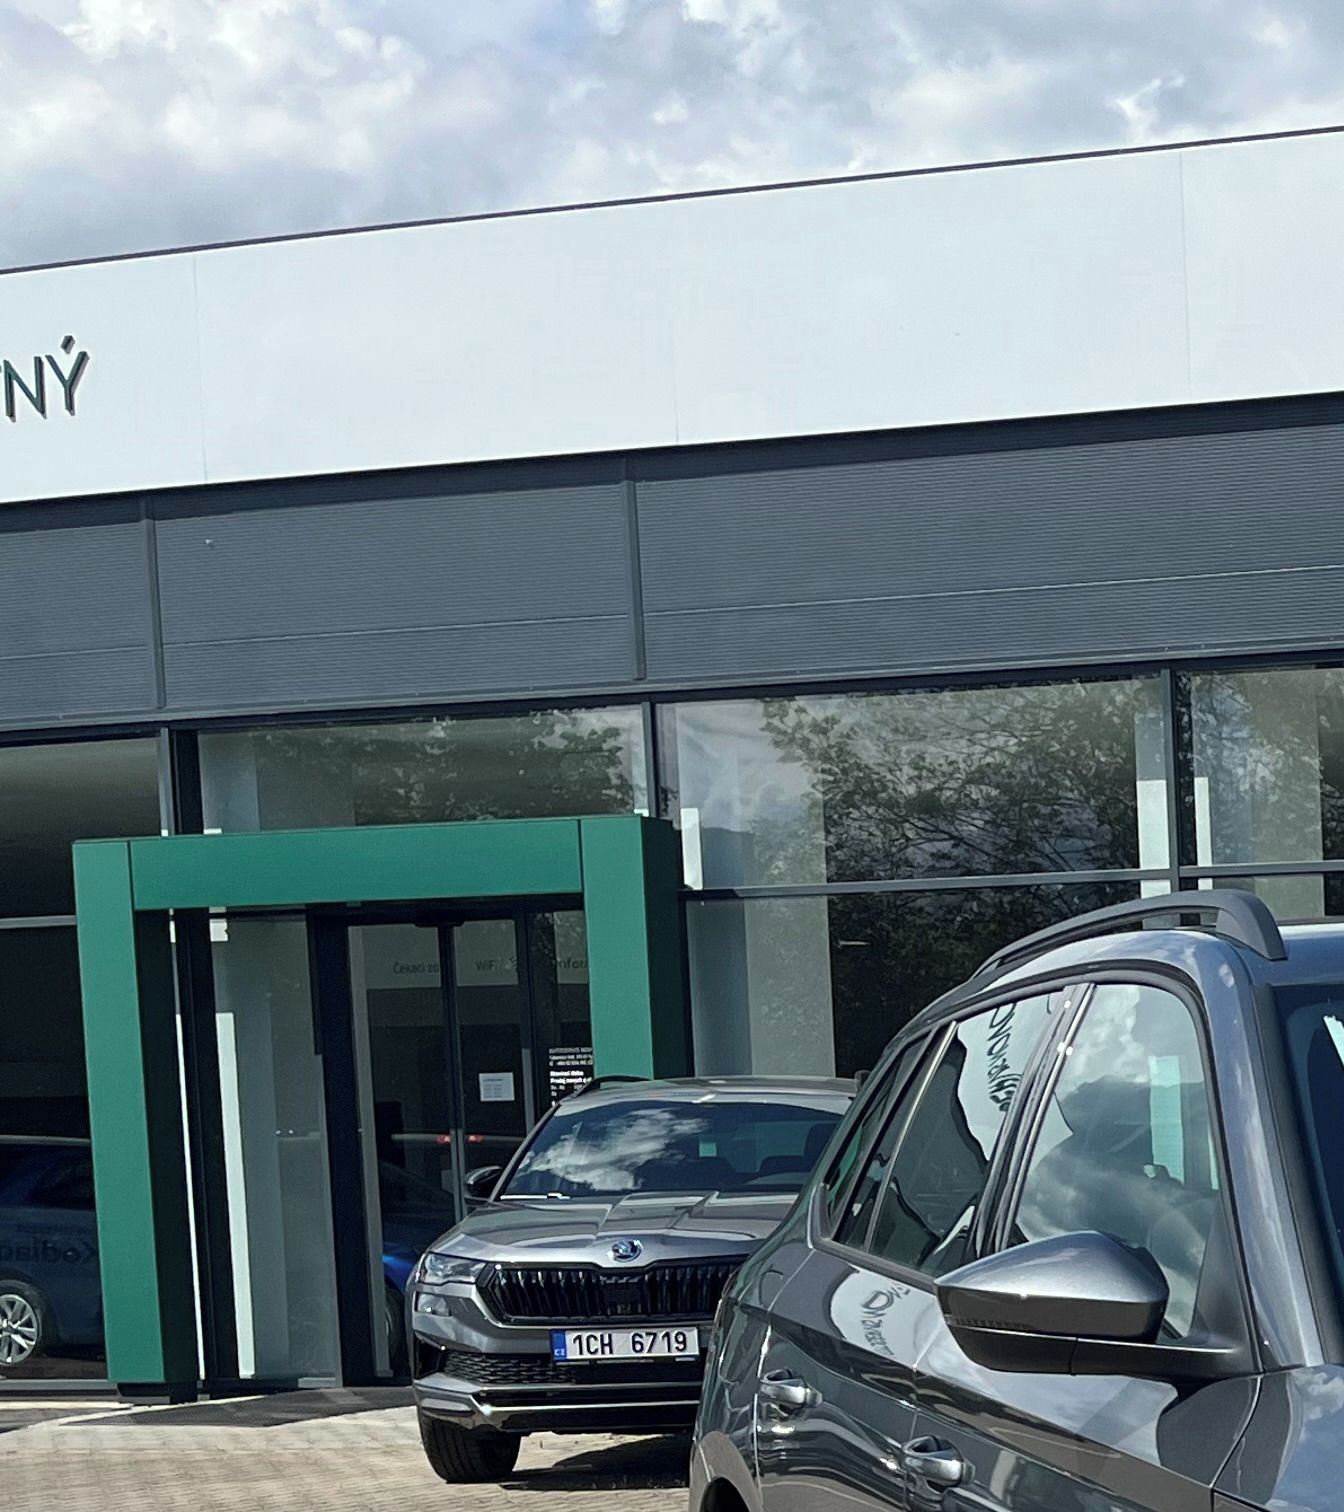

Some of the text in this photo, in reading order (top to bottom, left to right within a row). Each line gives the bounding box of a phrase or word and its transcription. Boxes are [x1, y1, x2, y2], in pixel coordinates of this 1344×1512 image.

[0, 335, 90, 422] NÝ
[554, 1348, 566, 1357] CZ
[572, 1331, 687, 1356] 1CH 6719
